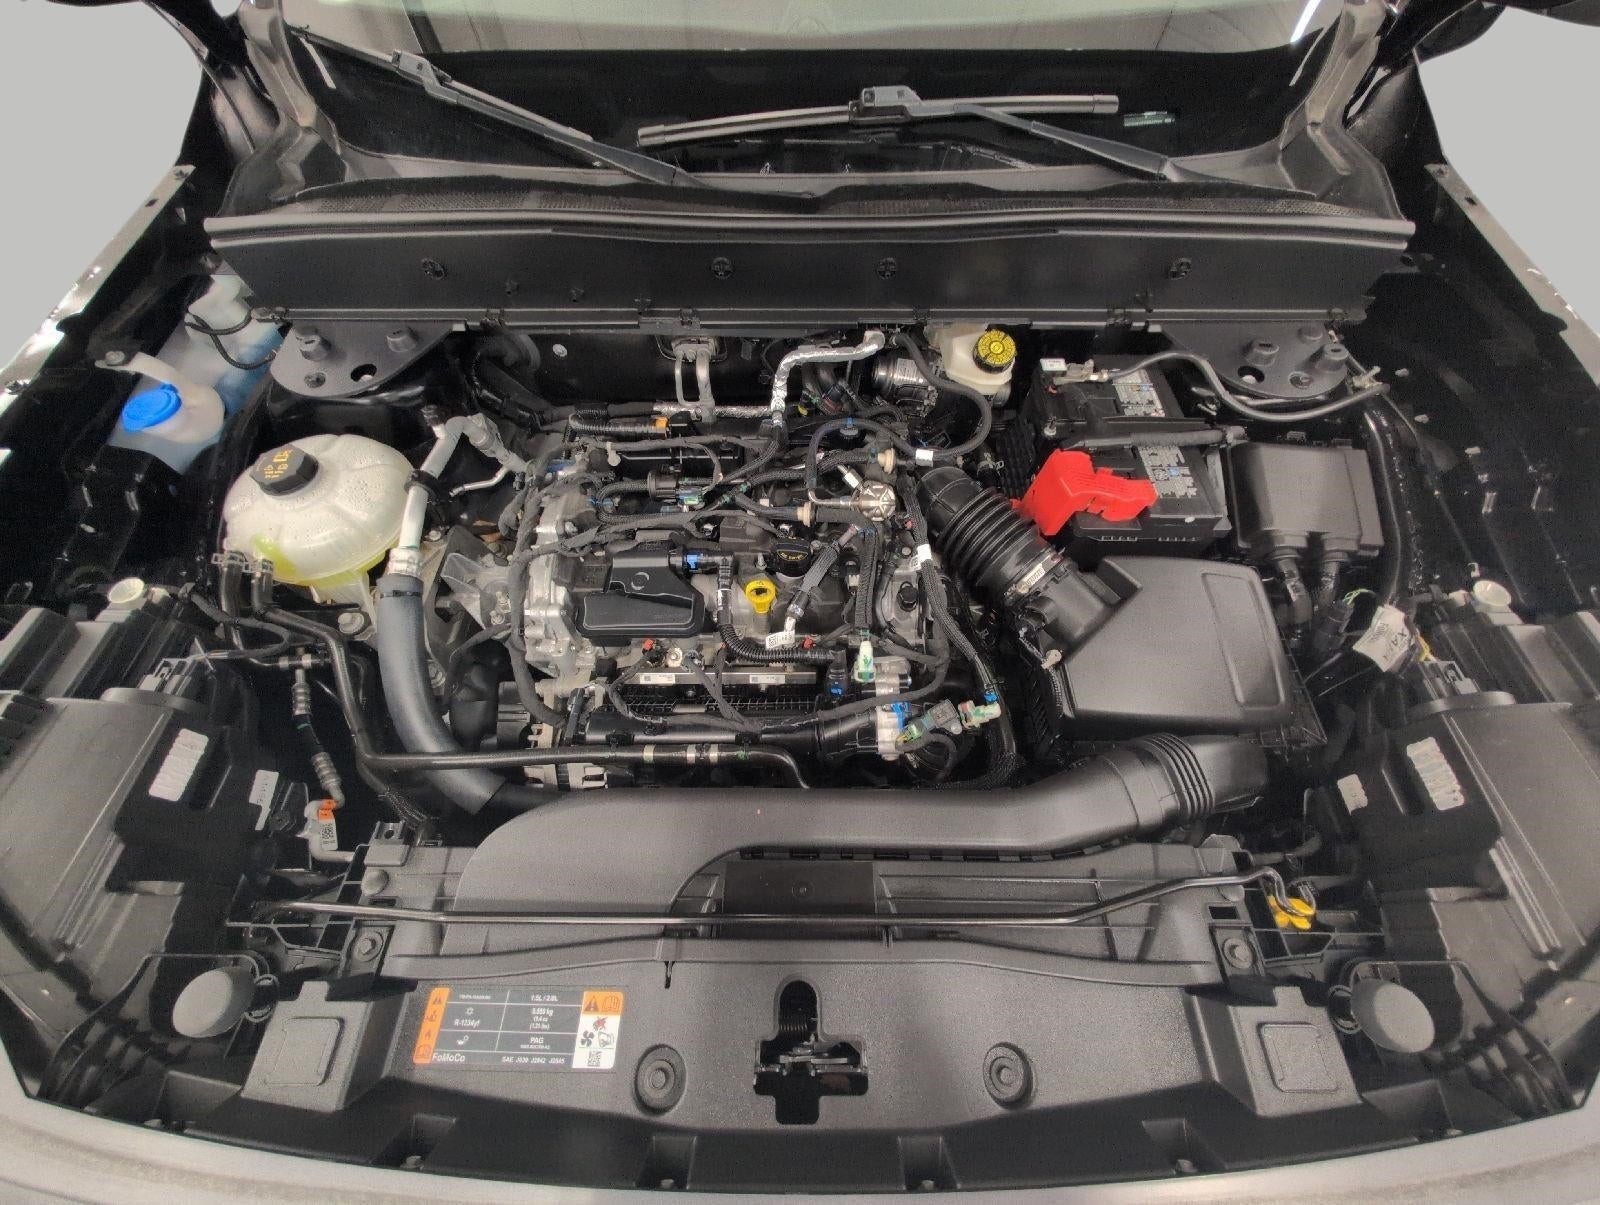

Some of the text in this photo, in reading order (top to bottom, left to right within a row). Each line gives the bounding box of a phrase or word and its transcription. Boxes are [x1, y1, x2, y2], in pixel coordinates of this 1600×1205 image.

[454, 1018, 480, 1028] R-1234yf
[530, 1036, 544, 1044] PAG
[432, 1052, 466, 1062] FoMoCo
[502, 1056, 514, 1064] SAE
